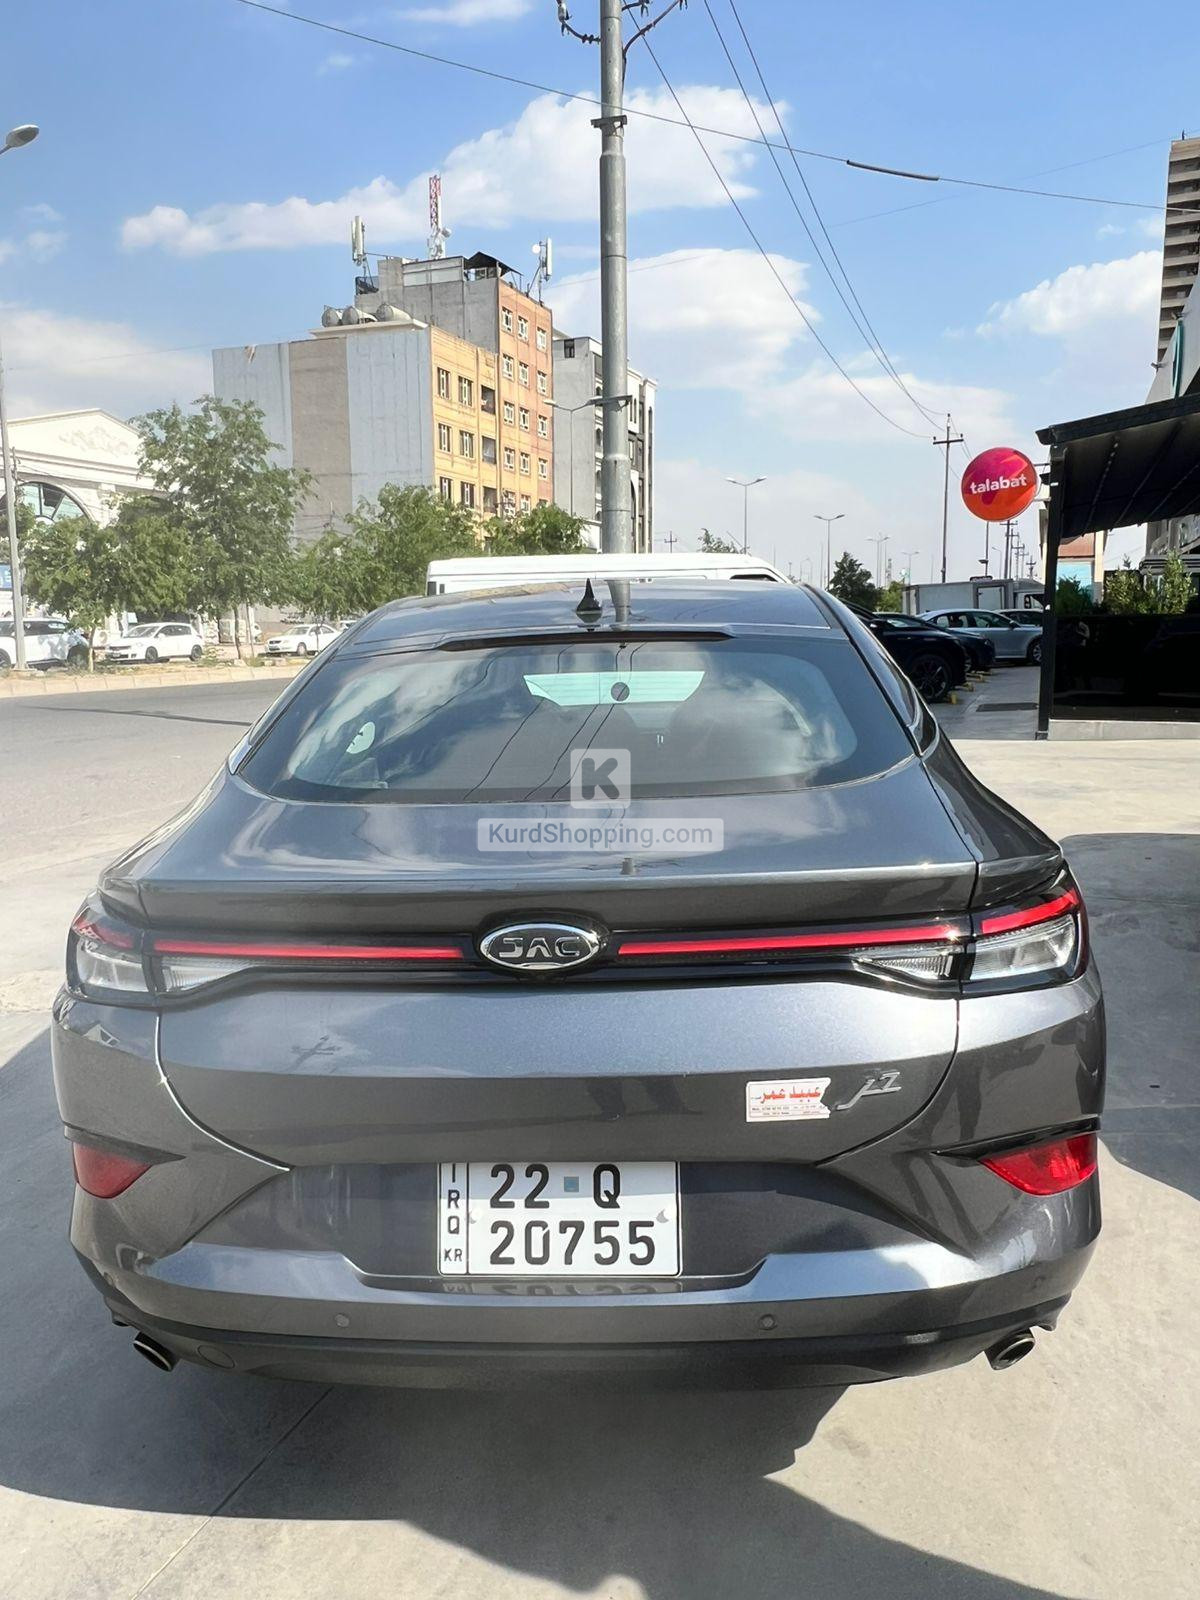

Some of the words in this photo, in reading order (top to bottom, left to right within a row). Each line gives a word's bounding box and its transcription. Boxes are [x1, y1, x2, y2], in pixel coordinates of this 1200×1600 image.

[970, 473, 1027, 494] talabat
[499, 937, 580, 958] JAC
[490, 1163, 550, 1209] 22
[593, 1163, 621, 1209] Q
[490, 1220, 656, 1266] 20755
[443, 1248, 463, 1262] KR
